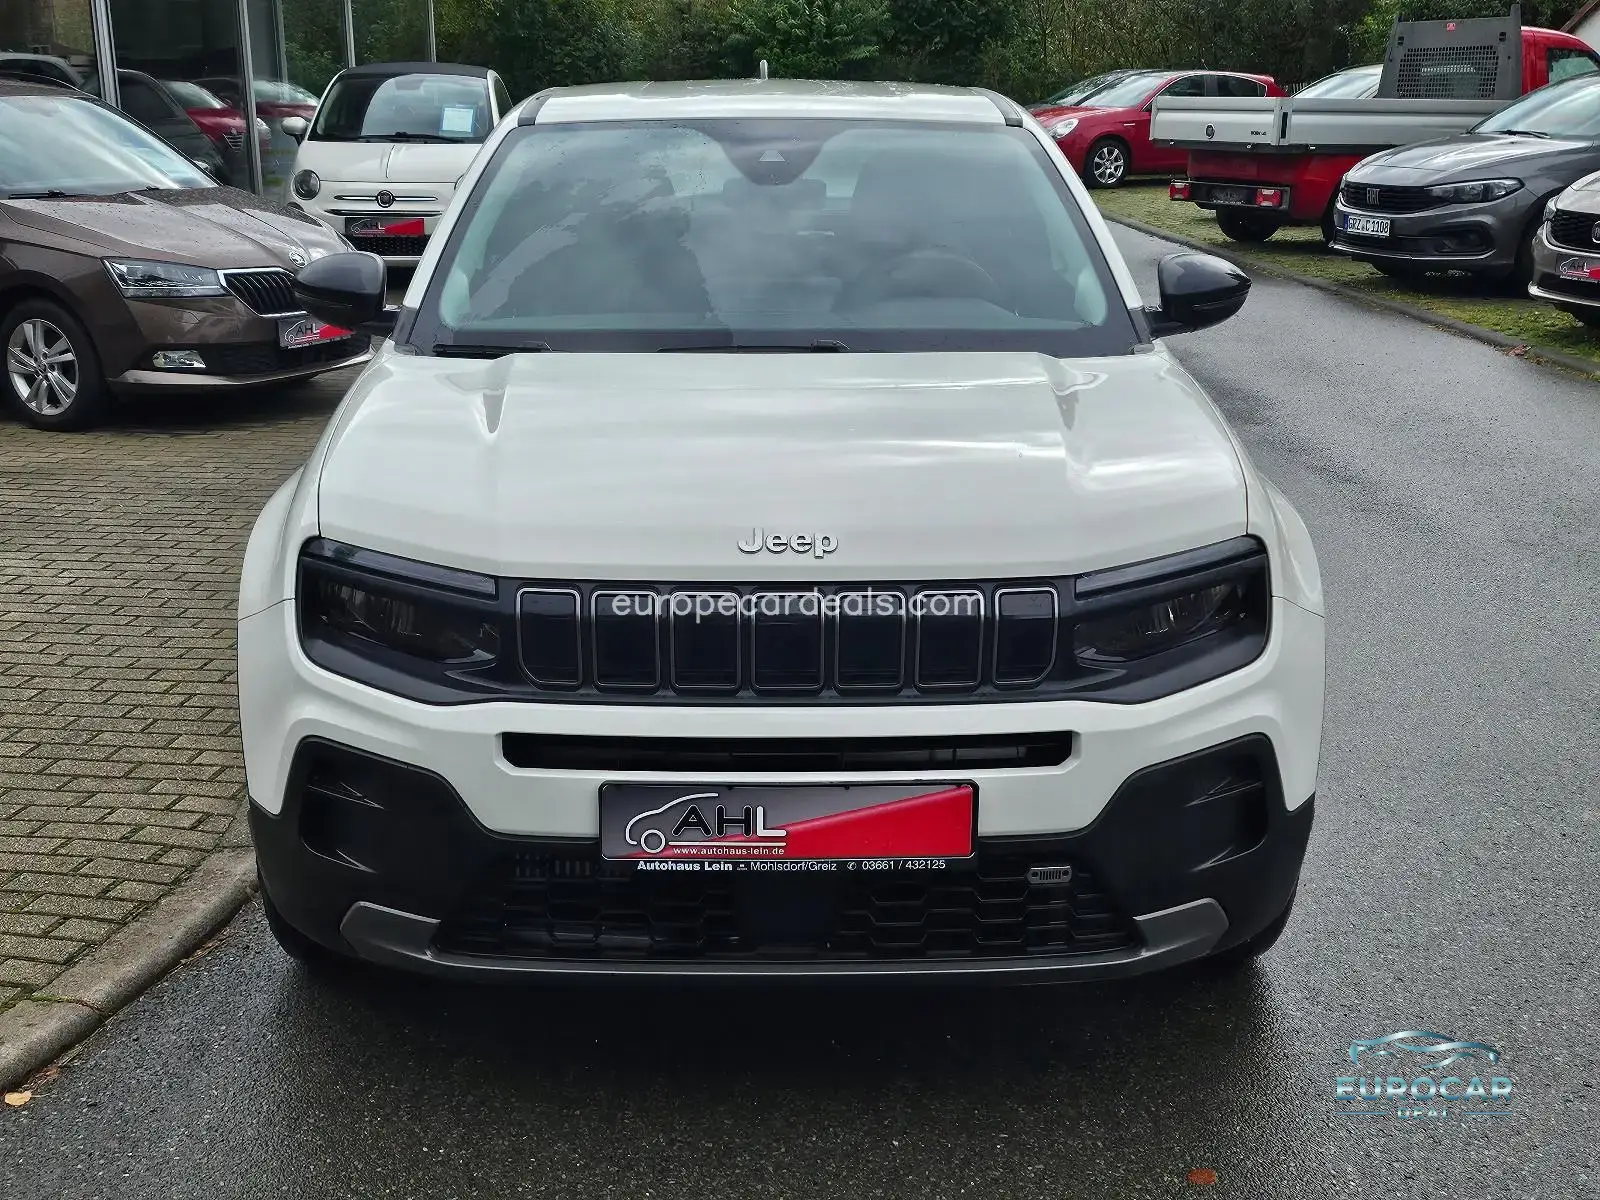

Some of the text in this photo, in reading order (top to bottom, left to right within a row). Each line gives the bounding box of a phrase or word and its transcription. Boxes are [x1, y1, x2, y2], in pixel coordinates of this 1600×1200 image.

[1366, 187, 1380, 206] FIAT
[295, 322, 320, 336] AHL
[737, 527, 839, 559] Jeep
[672, 804, 787, 837] AHL
[673, 847, 785, 855] www.autohaus-lein.de
[637, 860, 701, 871] Autohaus
[704, 860, 733, 871] Lein
[750, 860, 837, 871] Mohlsdorf/Greiz
[862, 860, 895, 870] 03661
[905, 859, 946, 870] 432125
